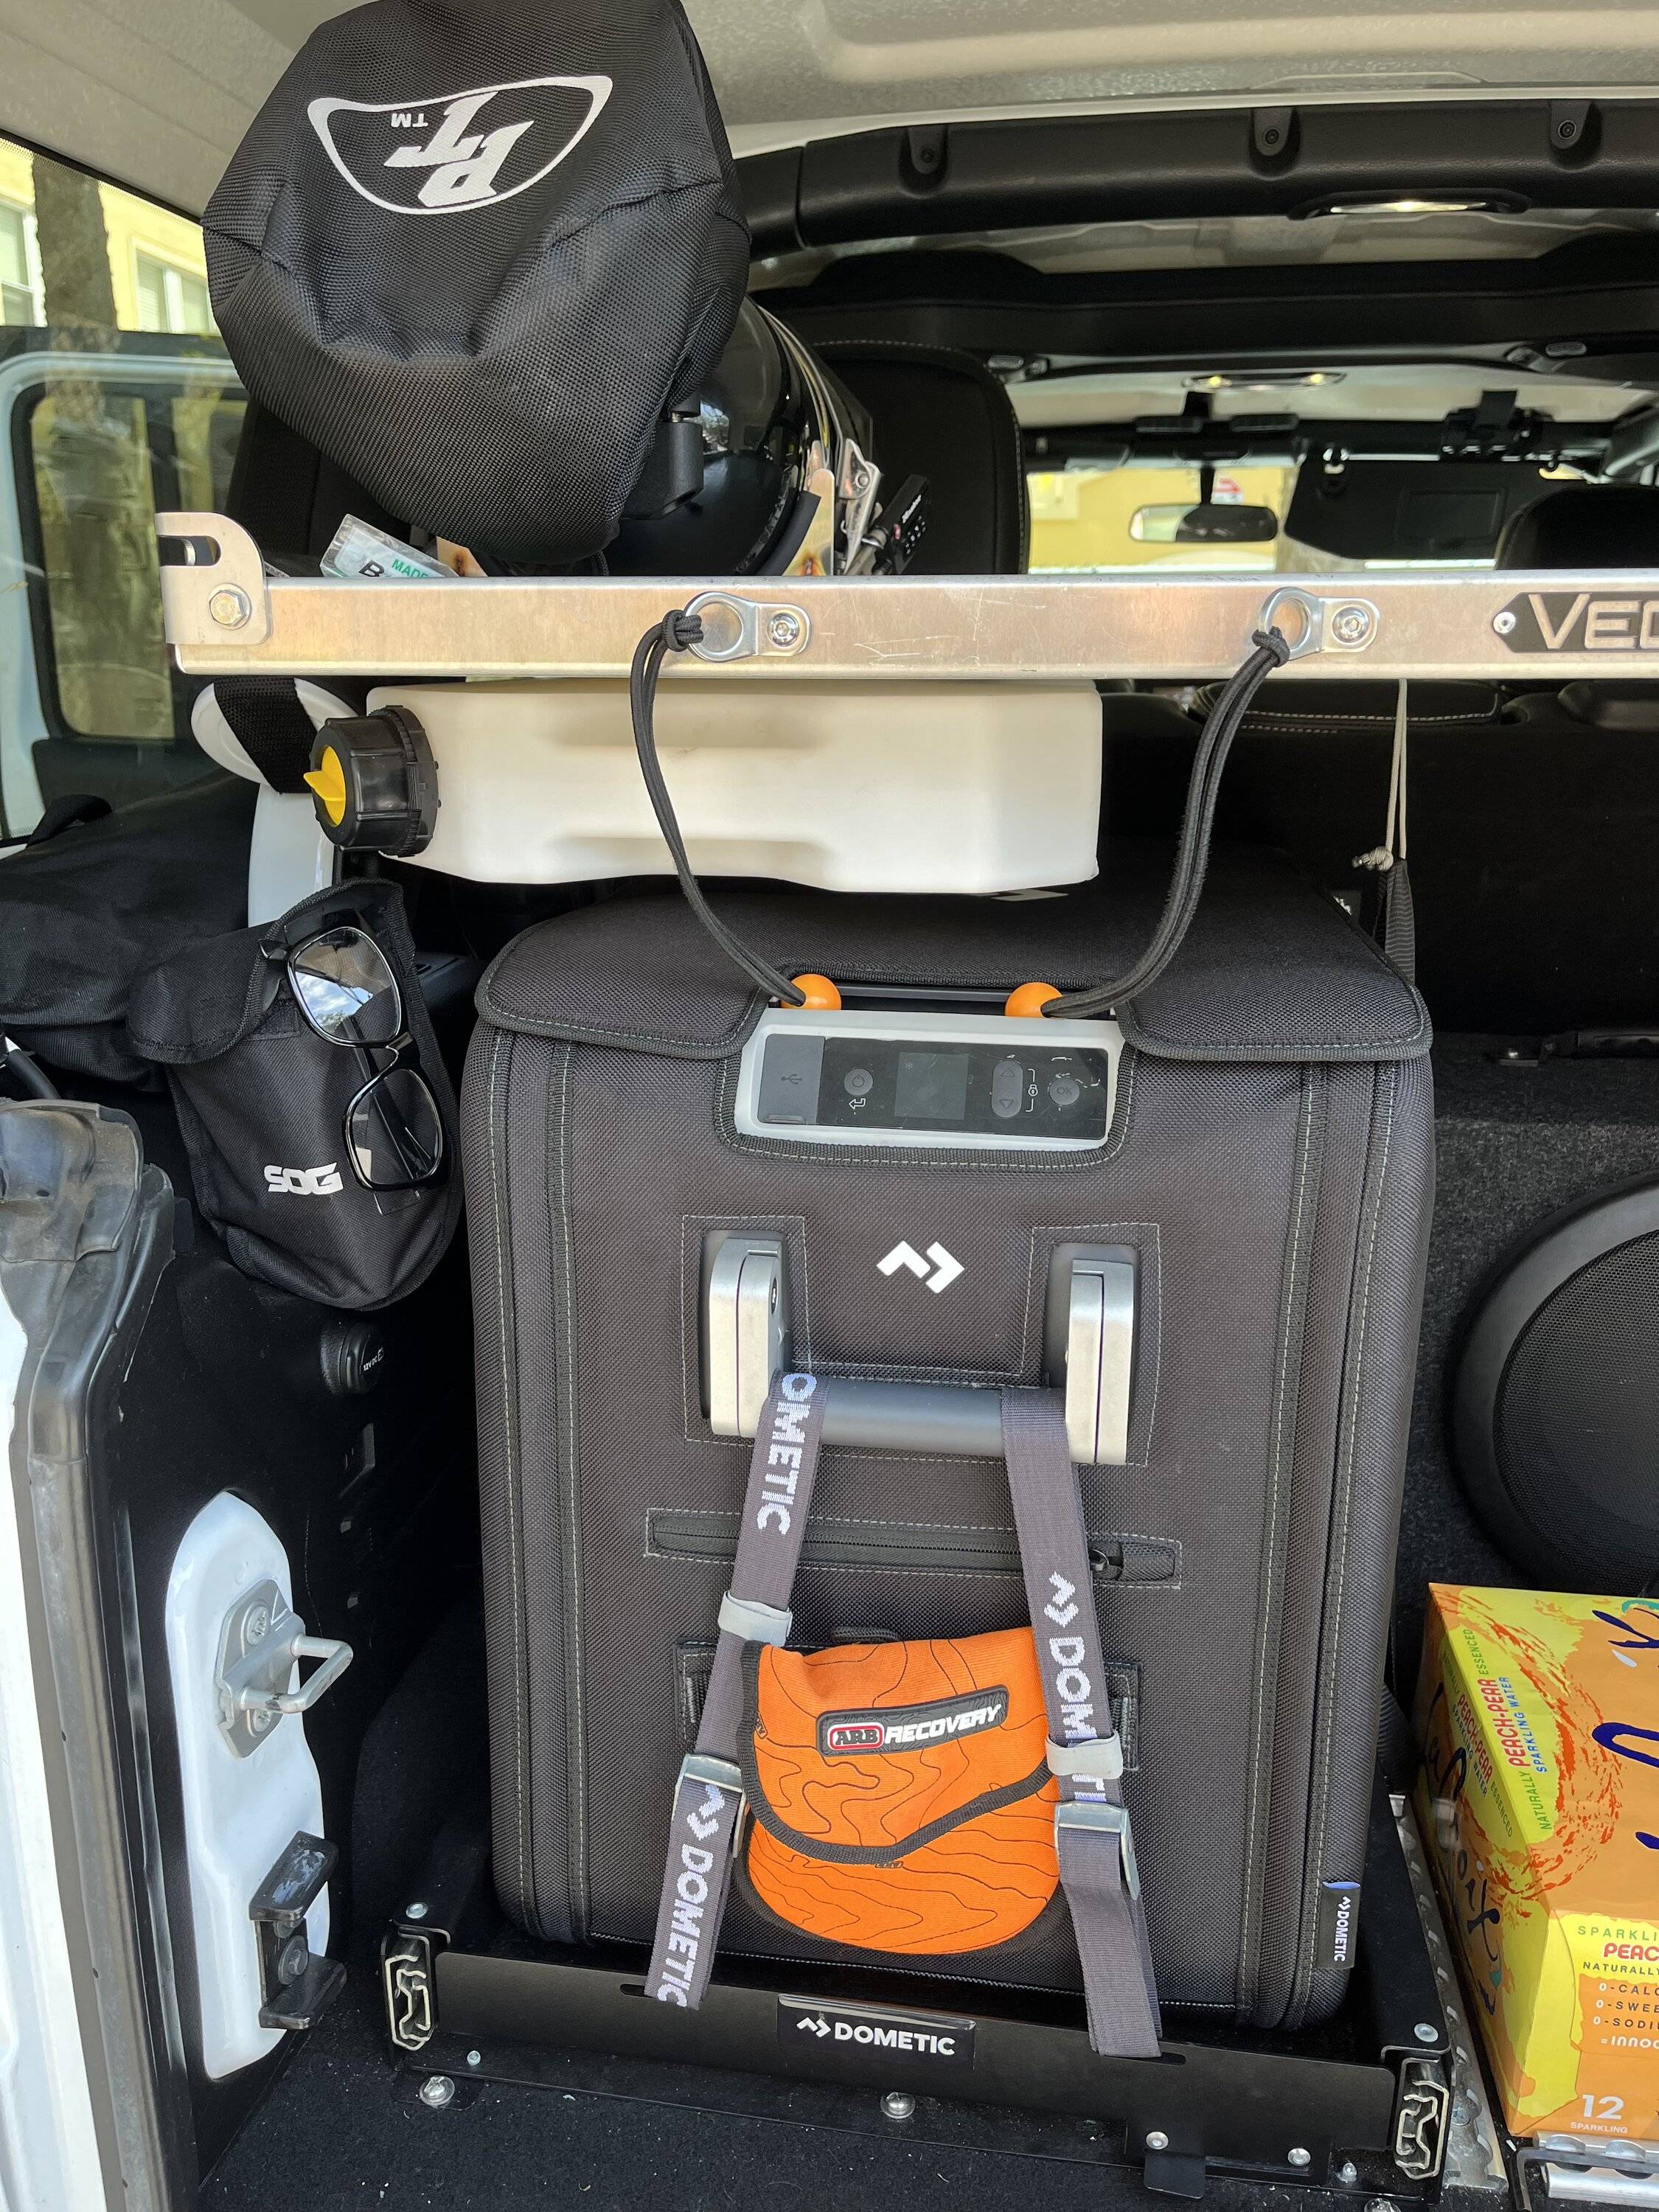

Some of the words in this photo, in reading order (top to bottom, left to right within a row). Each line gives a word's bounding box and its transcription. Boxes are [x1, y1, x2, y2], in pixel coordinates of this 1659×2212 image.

[391, 113, 428, 128] TM
[1057, 1086, 1073, 1095] OK
[264, 1162, 344, 1195] SOG
[1463, 1629, 1489, 1675] ESSENCED
[1499, 1677, 1520, 1708] WATER
[835, 1729, 878, 1745] ARB
[885, 1704, 1001, 1744] RECOVERY
[1049, 1636, 1106, 1801] DOMTI
[1478, 1678, 1531, 1767] PEACH-PEAR
[1452, 1704, 1473, 1759] SPARKLING
[1474, 1760, 1487, 1797] WATER
[1514, 1712, 1547, 1773] SPARKLING
[1458, 1694, 1493, 1784] PEACH-PEAR
[1491, 1781, 1512, 1837] ESSENCED
[1519, 1771, 1551, 1830] NATURALLY
[657, 1844, 713, 2007] DOMETIC
[1334, 1910, 1350, 1962] DOMETIC
[1578, 1926, 1657, 1941] SPARKLI
[1604, 1943, 1659, 1961] PEAC
[835, 2022, 956, 2056] DOMETIC
[1593, 2017, 1659, 2030] 0-SODI
[1582, 2094, 1624, 2120] 12
[1570, 2122, 1628, 2134] SPARKLING
